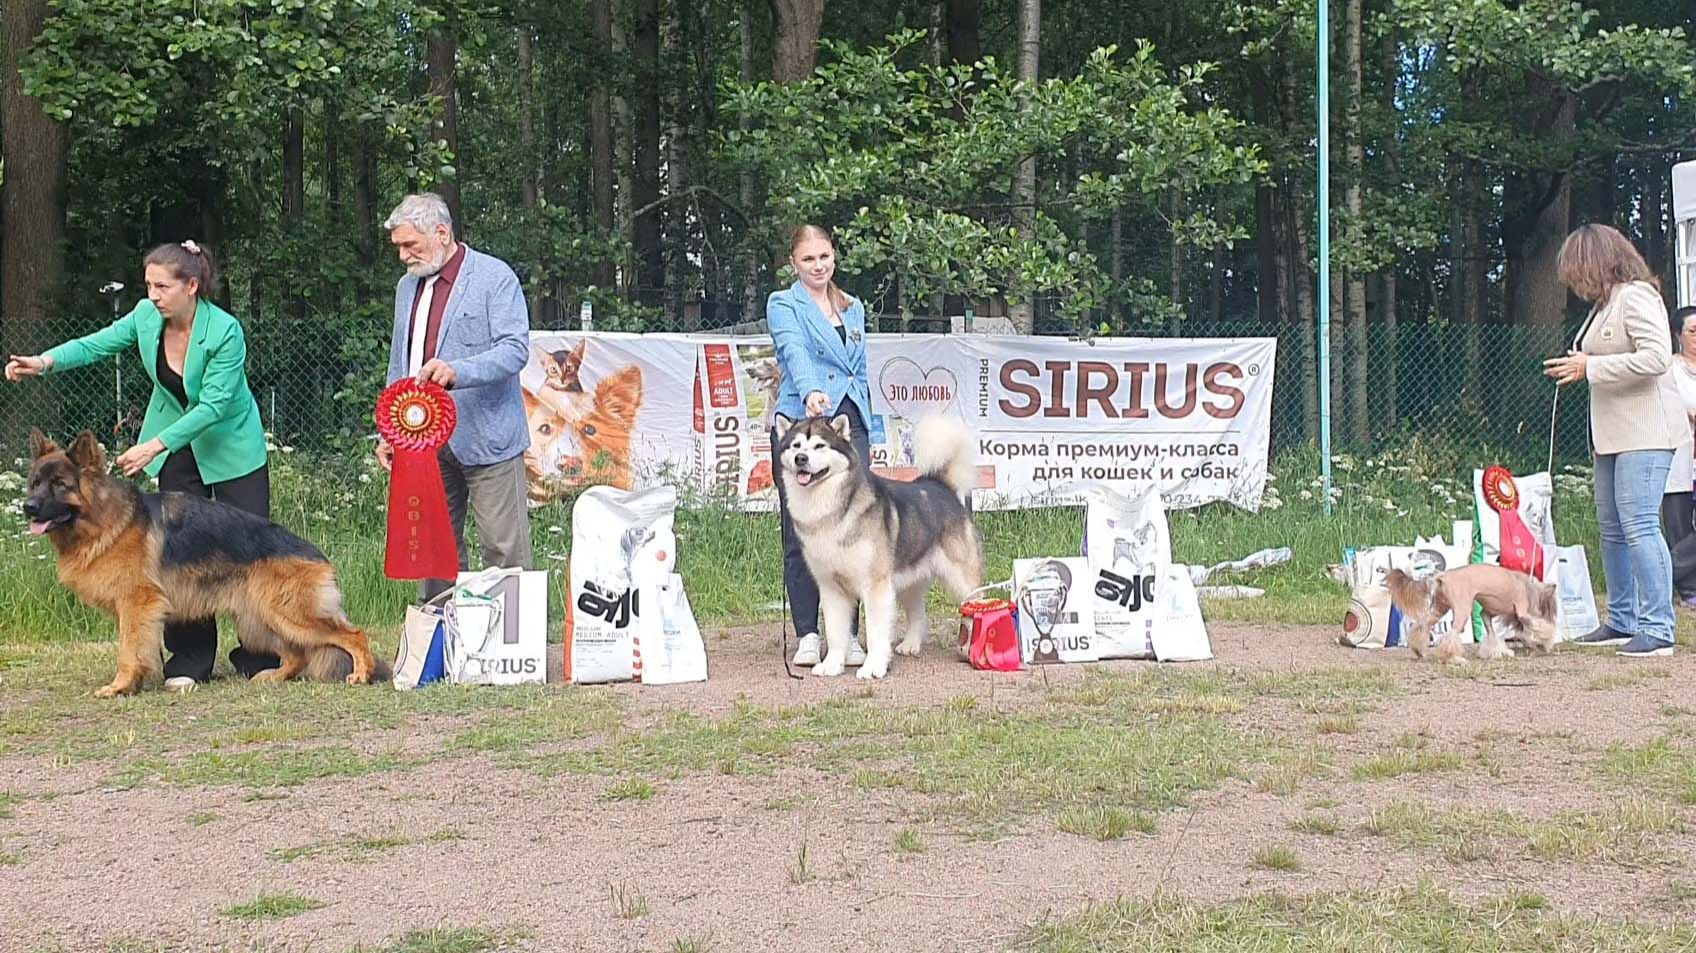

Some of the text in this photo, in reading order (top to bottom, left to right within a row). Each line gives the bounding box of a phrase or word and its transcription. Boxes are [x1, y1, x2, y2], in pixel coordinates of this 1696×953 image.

[979, 358, 989, 417] PREMIUM
[998, 358, 1246, 419] SIRIUS
[979, 440, 1239, 460] Корма премиум-класса
[1032, 465, 1074, 481] для
[1081, 464, 1151, 480] кошек
[1161, 465, 1174, 480] и
[484, 575, 520, 644] 1
